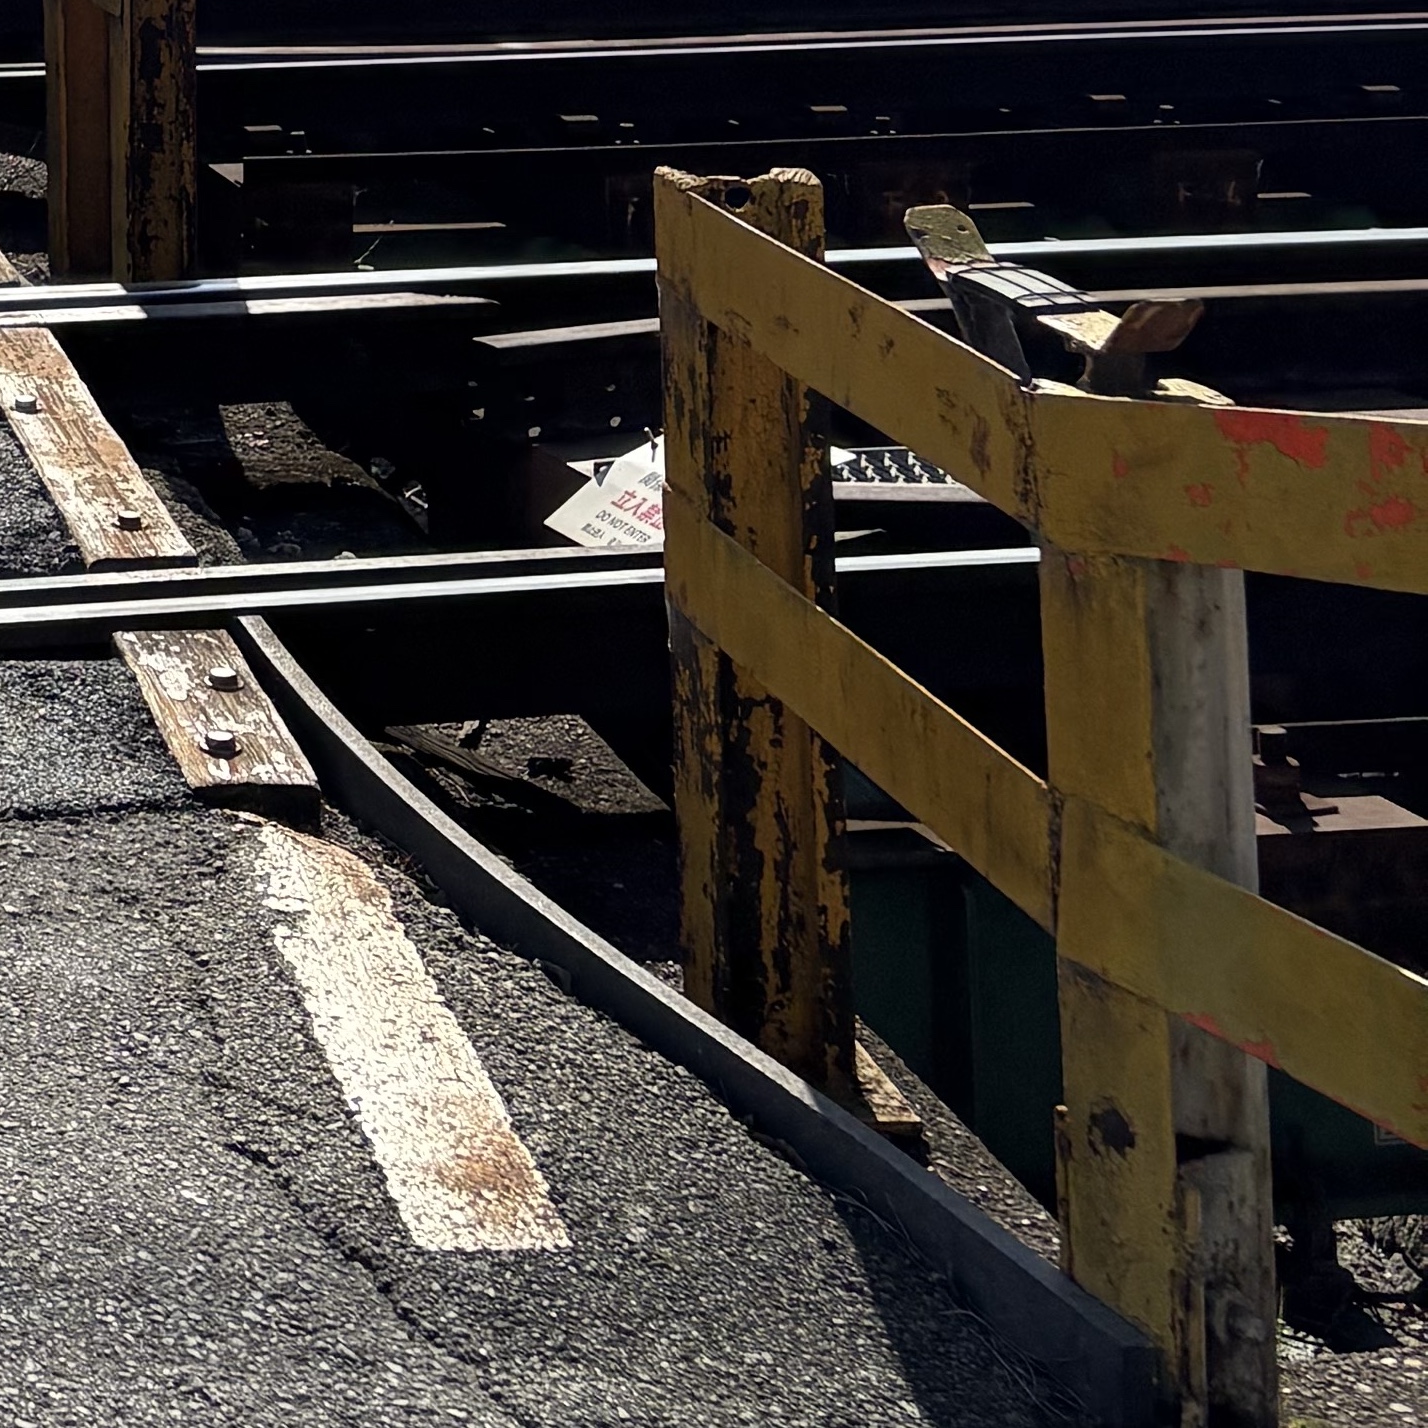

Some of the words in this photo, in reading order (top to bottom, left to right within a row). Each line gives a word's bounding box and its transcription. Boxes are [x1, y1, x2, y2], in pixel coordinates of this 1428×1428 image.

[595, 509, 611, 522] DO
[608, 516, 629, 531] NOT
[624, 525, 651, 543] ENTER
